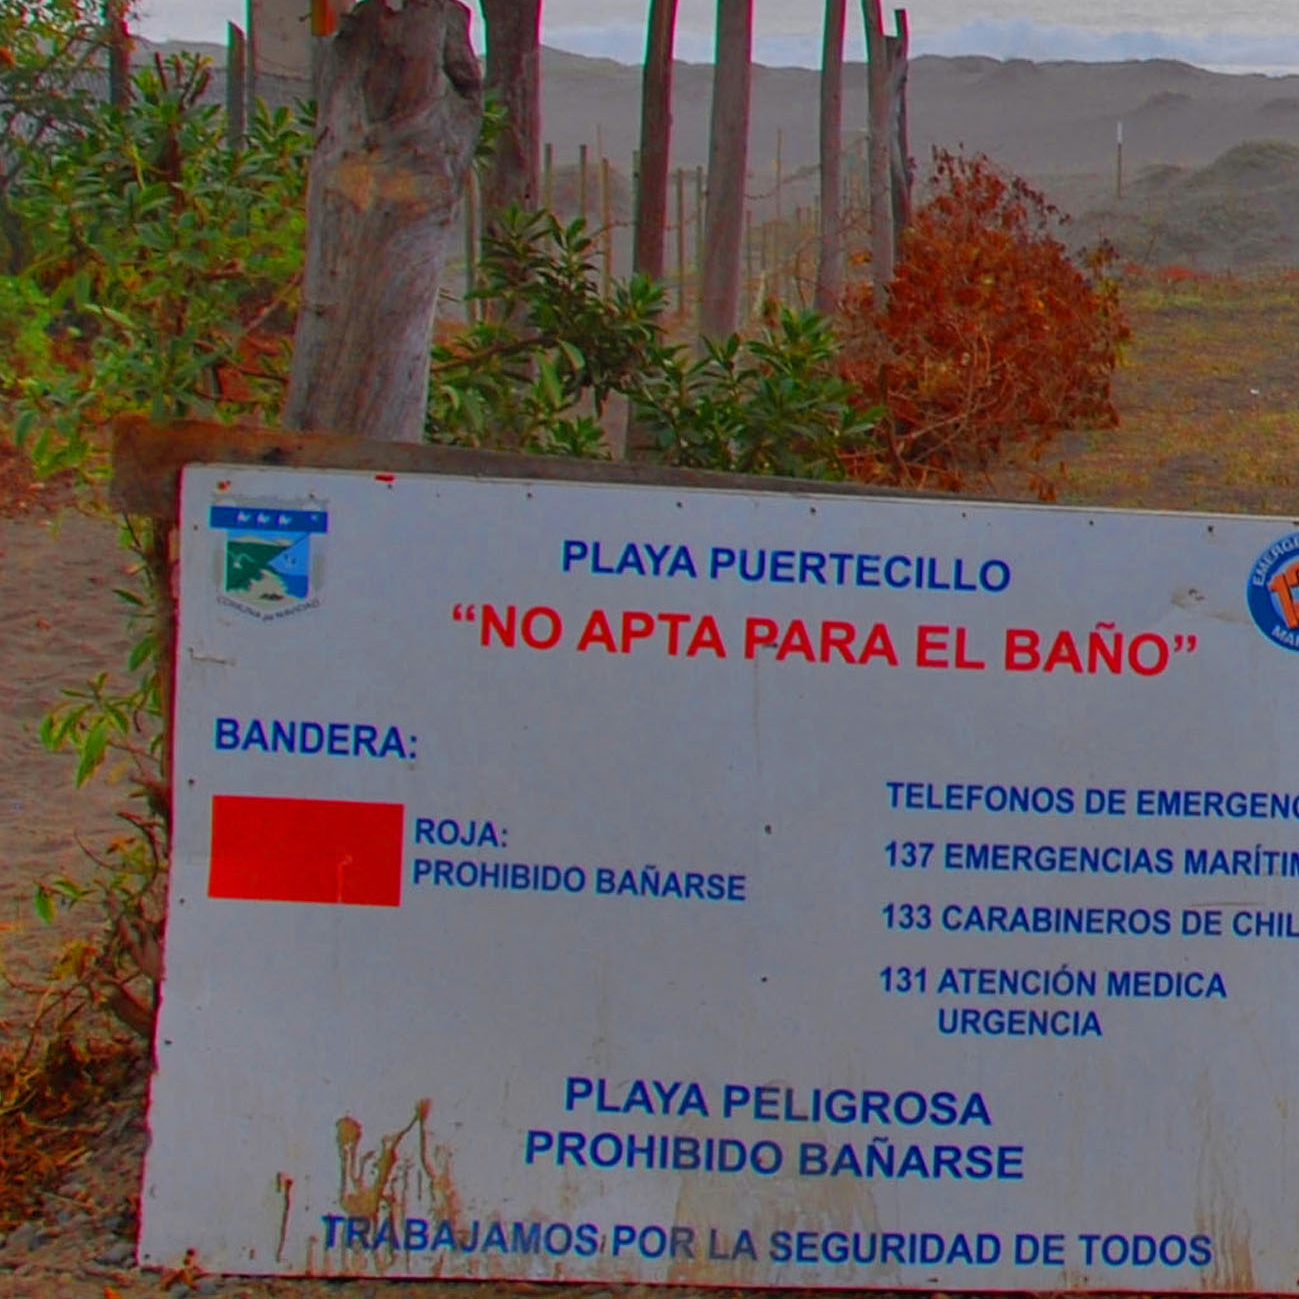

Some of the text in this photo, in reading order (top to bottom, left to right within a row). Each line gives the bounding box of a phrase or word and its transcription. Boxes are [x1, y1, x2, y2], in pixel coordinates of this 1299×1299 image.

[559, 537, 1012, 596] PLAYA PUERTECILLO
[576, 607, 728, 660] APTA
[743, 615, 901, 669] PARA
[914, 623, 988, 674] EL
[212, 715, 420, 763] BANDERA:
[884, 779, 1077, 818] TELEFONOS
[1082, 786, 1128, 820] DE
[411, 815, 510, 852] ROJA:
[410, 856, 748, 905] PROHIBIDO BAÑARSE
[882, 838, 936, 871] 137
[941, 841, 1175, 878] EMERGENCIAS
[879, 902, 933, 934] 133
[939, 903, 1173, 939] CARABINEROS
[1179, 909, 1223, 939] DE
[877, 962, 1229, 1002] 131 ATENCIÓN MEDICA
[935, 1006, 1105, 1040] URGENCIA
[562, 1075, 994, 1130] PLAYA PELIGROSA
[522, 1128, 1026, 1182] PROHIBIDO BAÑARSE
[319, 1213, 1214, 1269] TRABAJAMOS POR LA SEGURIDAD DE TODOS
